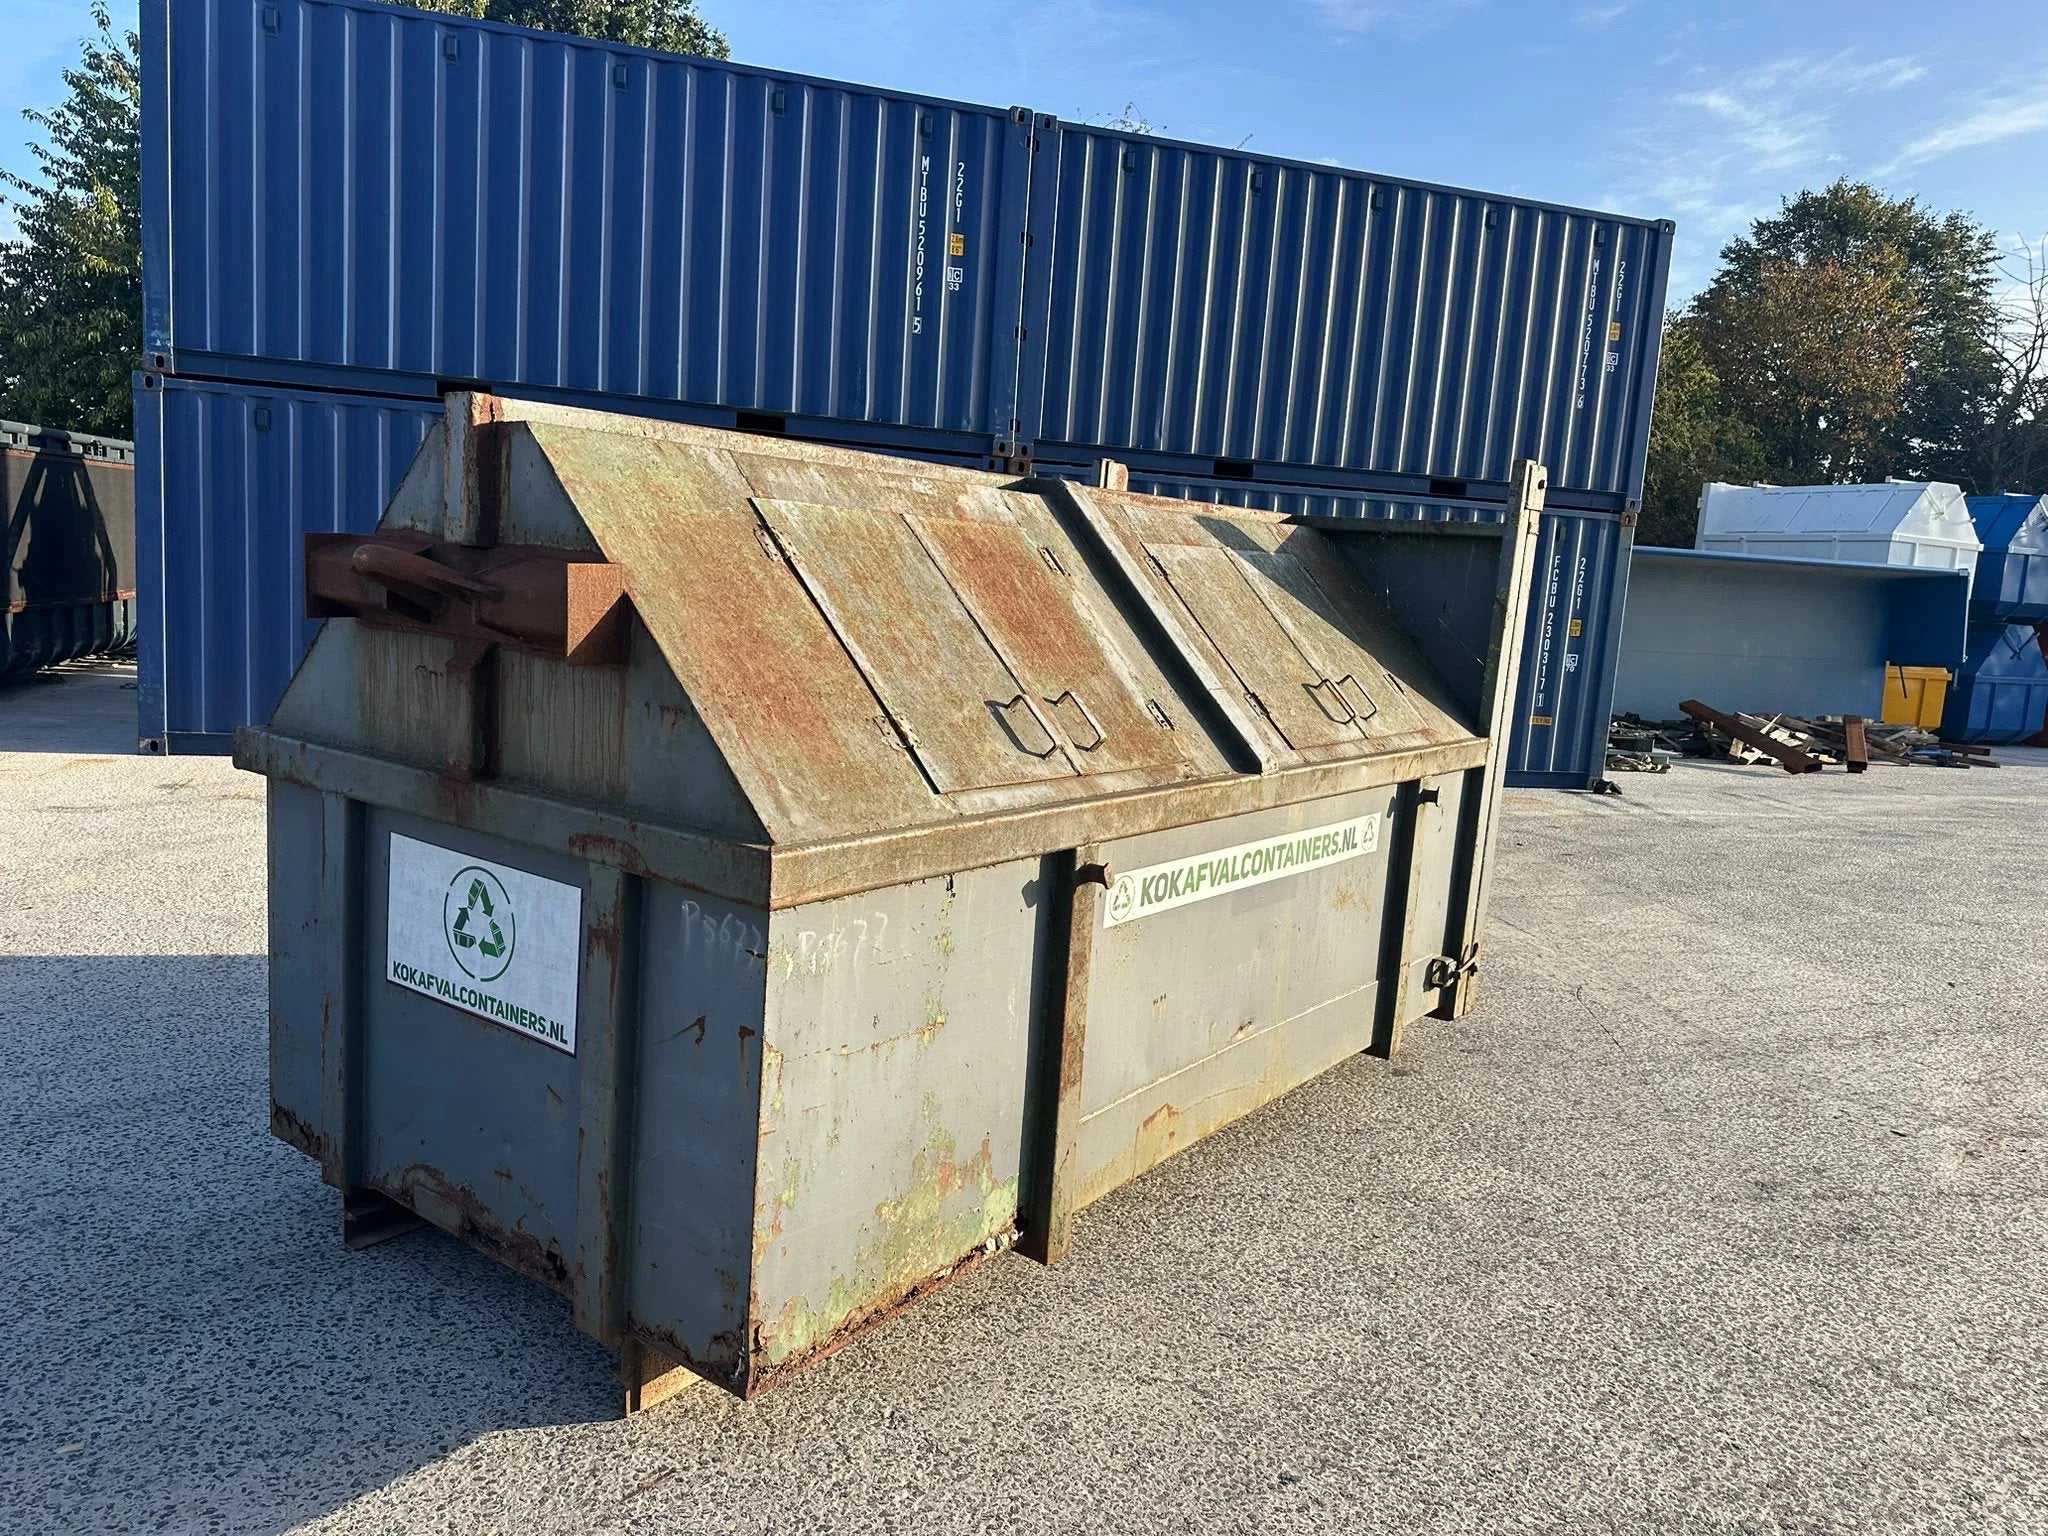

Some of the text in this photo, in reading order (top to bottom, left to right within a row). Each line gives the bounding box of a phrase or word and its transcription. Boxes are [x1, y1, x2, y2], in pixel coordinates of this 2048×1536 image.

[955, 162, 965, 223] 22G1
[1616, 261, 1626, 312] 22G1
[1576, 557, 1587, 610] 22G1
[1140, 826, 1359, 908] KOKAFVALCONTAINERS.NL
[392, 960, 569, 1045] KOKAFVALCONTAINERS.NL
